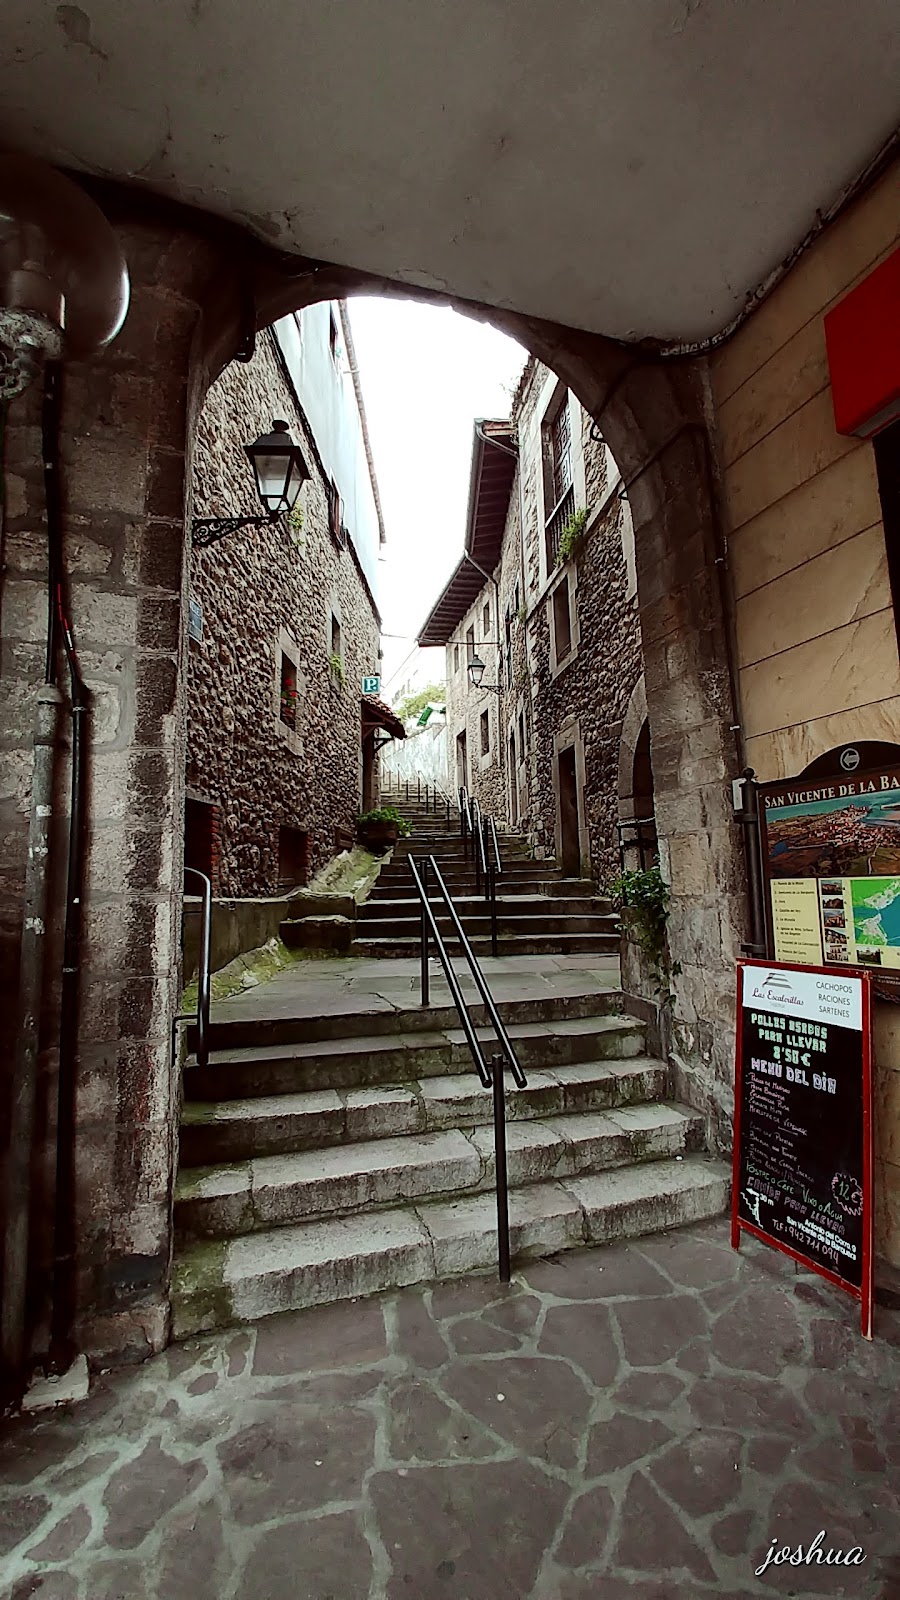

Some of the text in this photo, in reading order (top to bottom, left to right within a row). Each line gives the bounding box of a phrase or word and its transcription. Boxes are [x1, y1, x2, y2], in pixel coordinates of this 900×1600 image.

[764, 795, 785, 809] SAN
[786, 787, 836, 804] VICENTE
[839, 783, 856, 797] DE
[859, 780, 876, 793] LA
[751, 988, 765, 998] Las
[815, 981, 853, 994] CACHOPOS
[818, 993, 851, 1006] RACIONES
[818, 1006, 850, 1018] SARTENES
[751, 1013, 785, 1030] POLLOS
[758, 1028, 826, 1053] PARA LLEVAR
[785, 1066, 809, 1086] DEL
